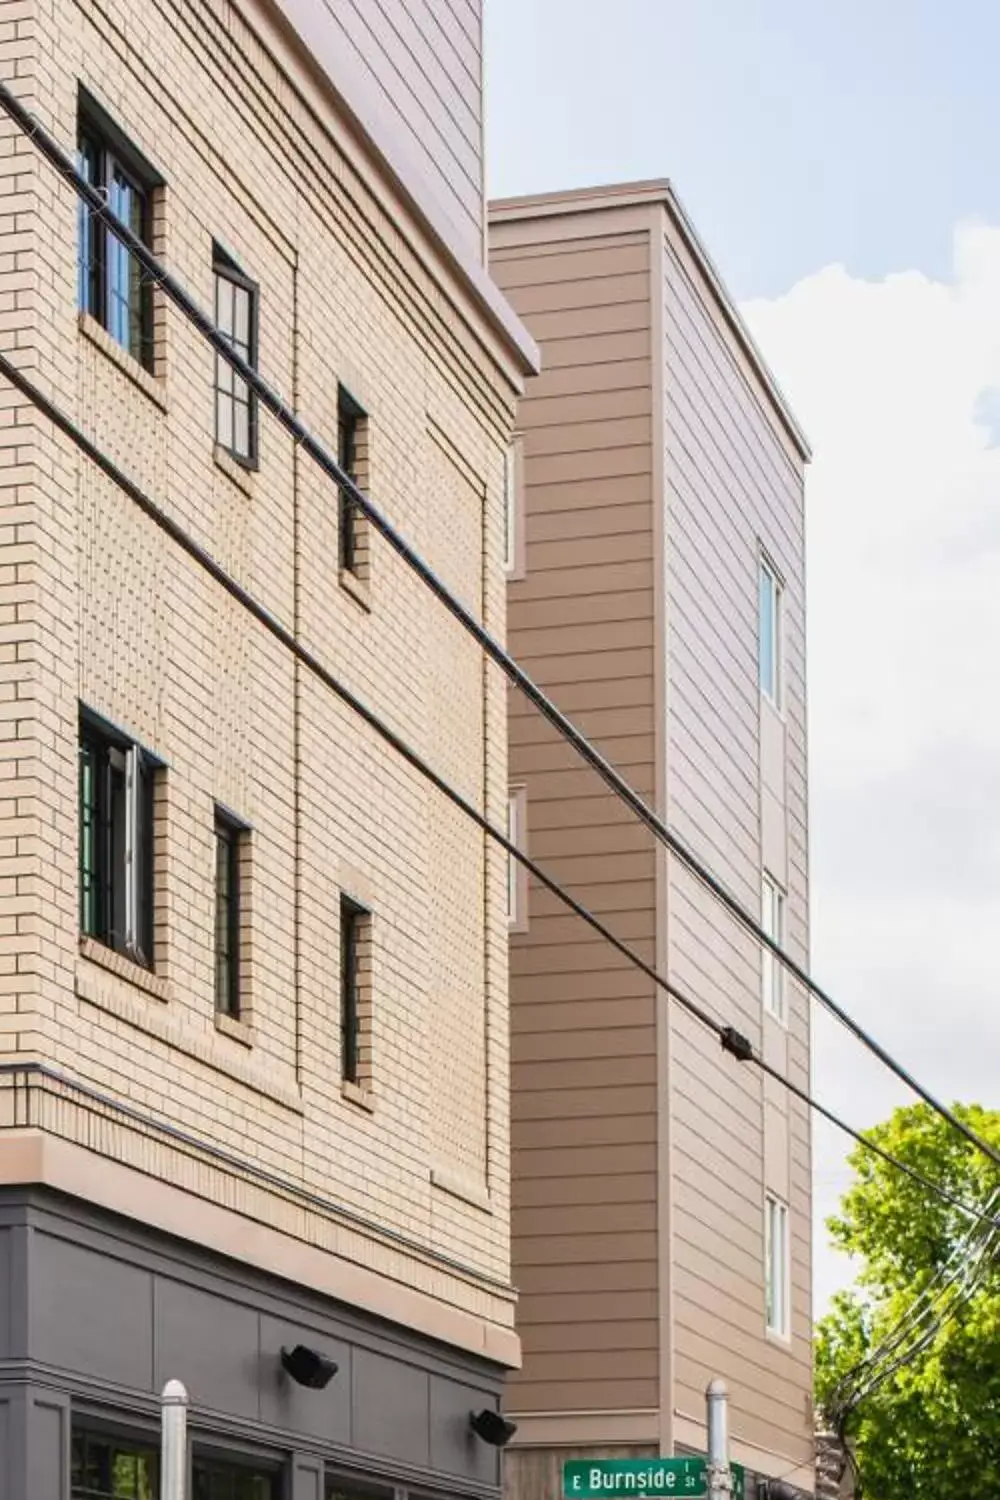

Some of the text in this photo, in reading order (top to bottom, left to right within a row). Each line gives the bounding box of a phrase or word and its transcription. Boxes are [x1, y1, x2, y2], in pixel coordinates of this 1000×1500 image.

[572, 1468, 695, 1490] E Burnside St
